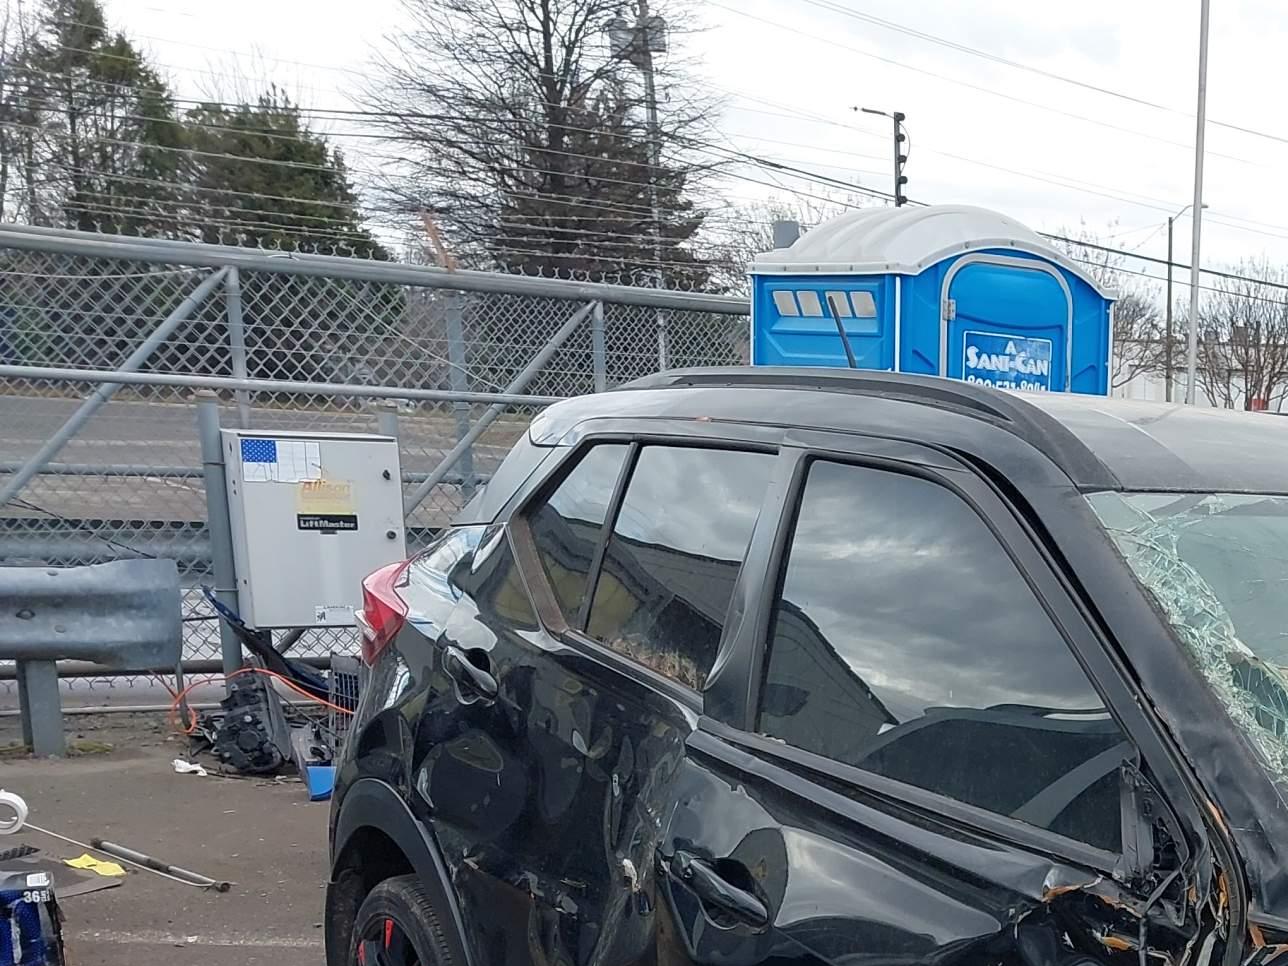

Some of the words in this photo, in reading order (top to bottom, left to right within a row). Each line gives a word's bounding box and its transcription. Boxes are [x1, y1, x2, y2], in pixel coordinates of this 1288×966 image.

[1004, 340, 1017, 355] A
[299, 519, 355, 529] LiftMaster
[23, 890, 40, 903] 36
